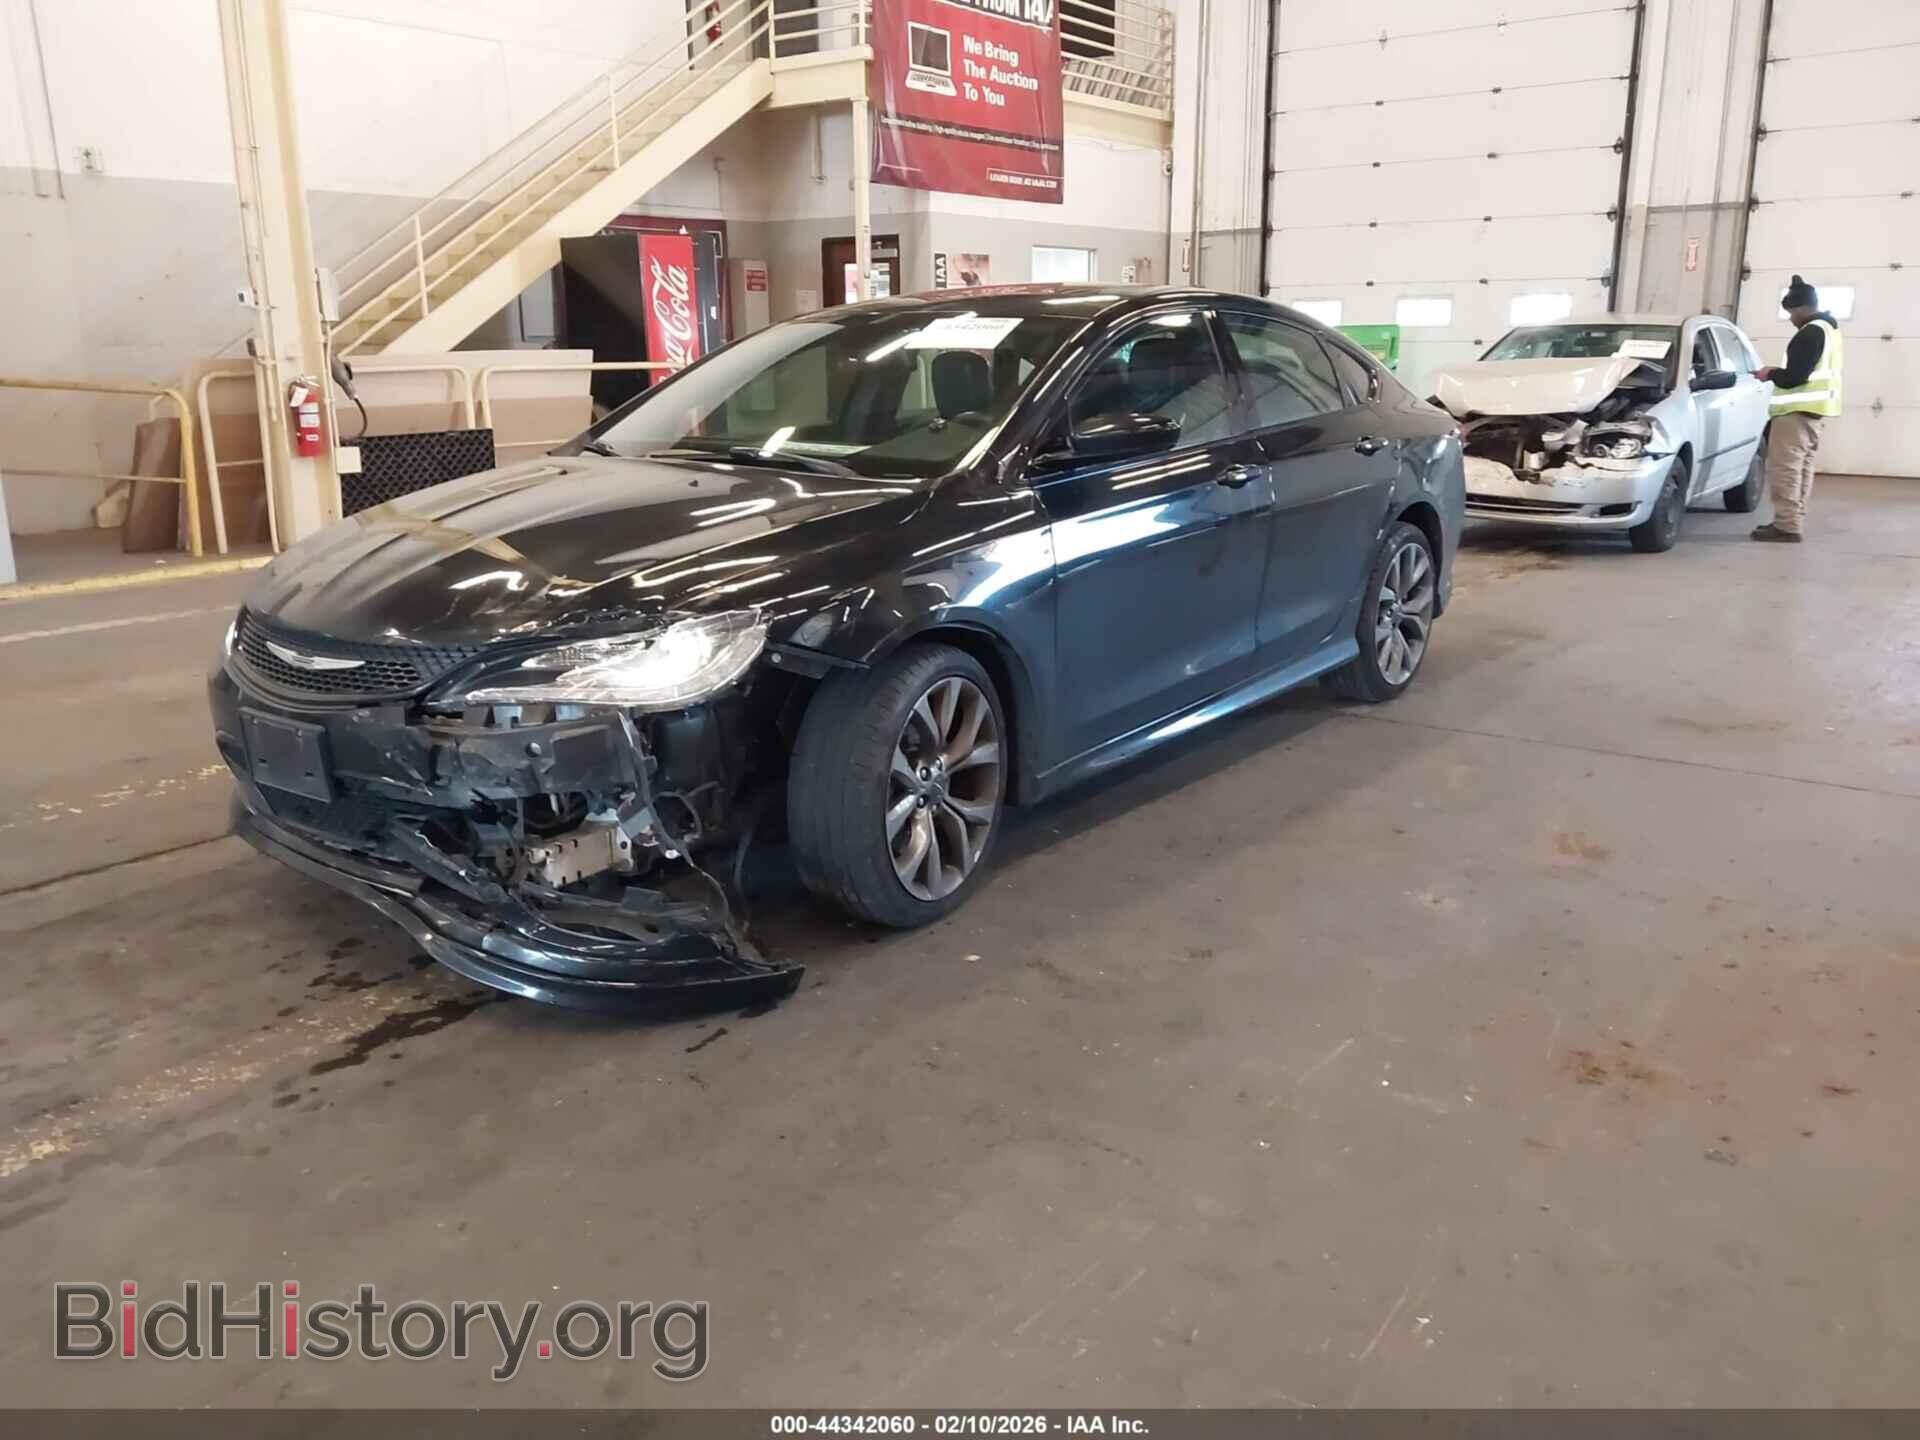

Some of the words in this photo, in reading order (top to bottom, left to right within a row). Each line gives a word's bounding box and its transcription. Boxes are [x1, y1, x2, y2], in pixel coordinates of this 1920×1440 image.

[962, 34, 983, 56] We
[984, 41, 1019, 67] Bring
[963, 59, 987, 79] The
[989, 66, 1038, 91] Auction
[963, 82, 979, 101] To
[982, 87, 1005, 107] You
[936, 256, 945, 282] IAA
